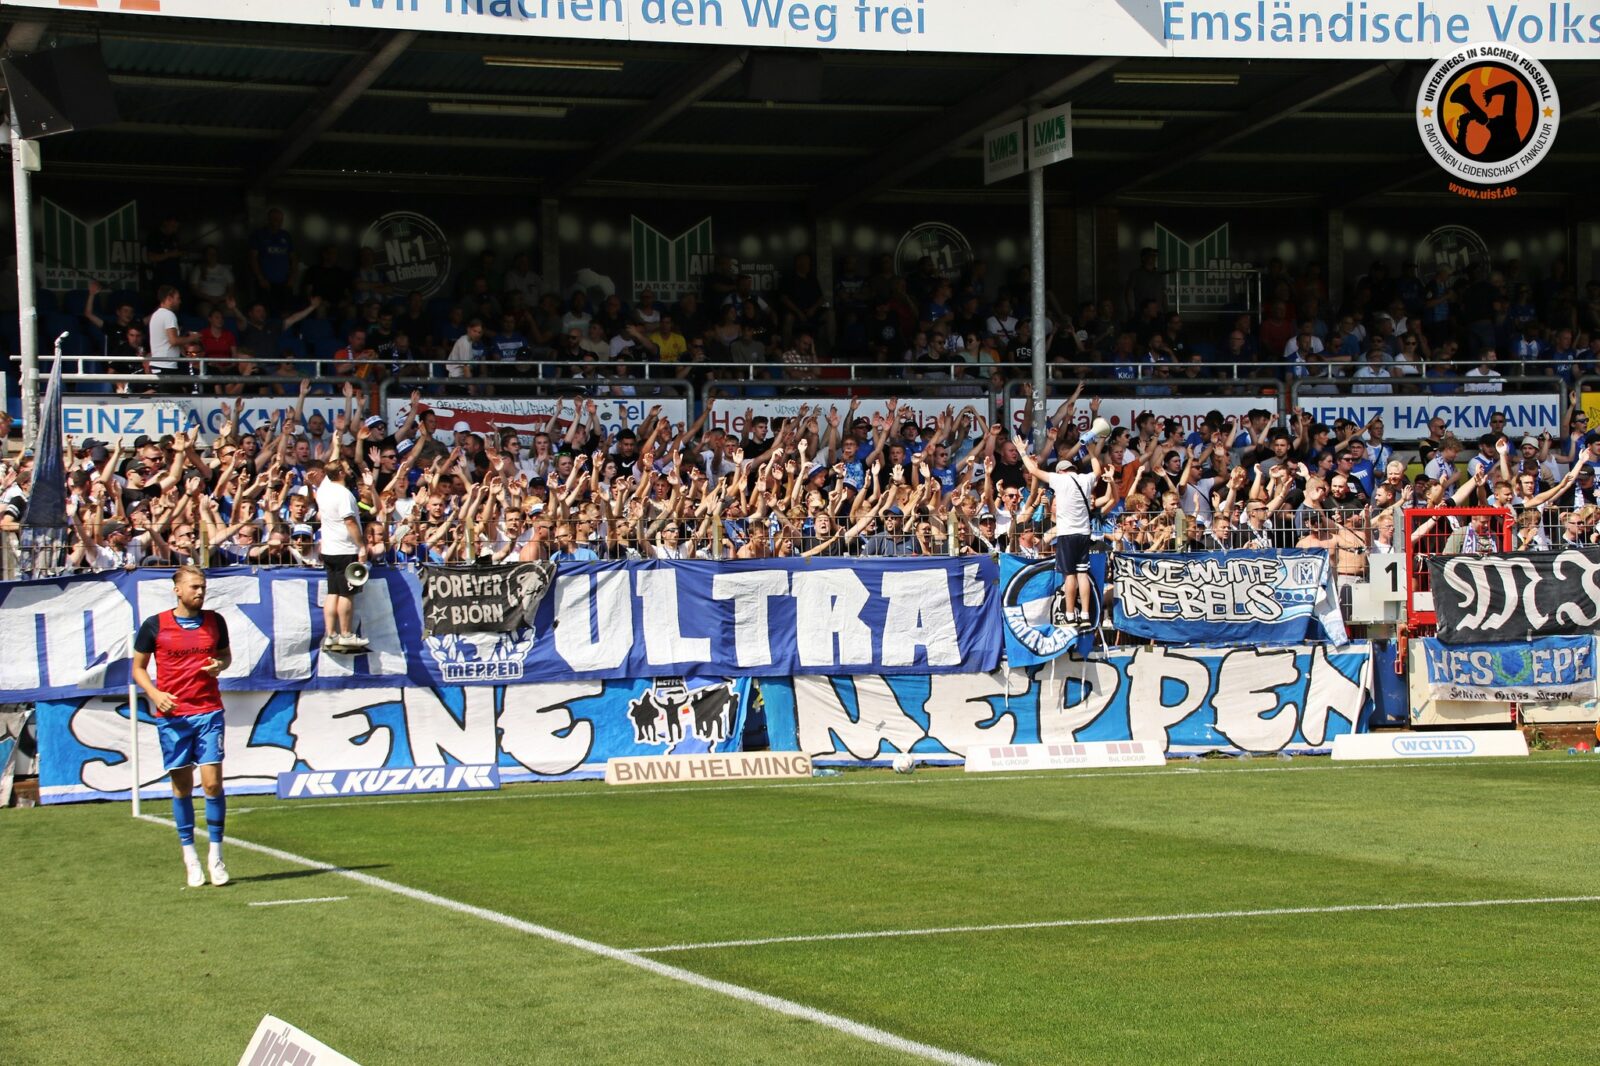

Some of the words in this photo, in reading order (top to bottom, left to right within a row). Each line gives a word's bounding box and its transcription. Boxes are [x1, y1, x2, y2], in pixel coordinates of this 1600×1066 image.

[641, 0, 723, 26] den
[741, 0, 838, 42] Weg
[854, 0, 925, 34] frei
[1163, 1, 1470, 43] Emsländische
[1487, 4, 1600, 46] Volks
[384, 234, 427, 266] Nr.1
[689, 253, 739, 275] Alls
[634, 282, 701, 291] MARKTKAU
[63, 408, 146, 434] EINZ
[612, 401, 645, 420] Tel
[1393, 405, 1557, 429] HACKMANN
[1116, 556, 1187, 583] BLUE
[1185, 558, 1282, 584] WHITE
[1384, 561, 1398, 592] 1
[427, 574, 504, 600] FOREVER
[450, 601, 505, 625] BJÖRN
[1120, 579, 1284, 622] REBELS
[1400, 736, 1469, 751] wavin
[341, 768, 446, 794] KUZKA
[614, 761, 681, 781] BMW
[689, 756, 812, 779] HELMING
